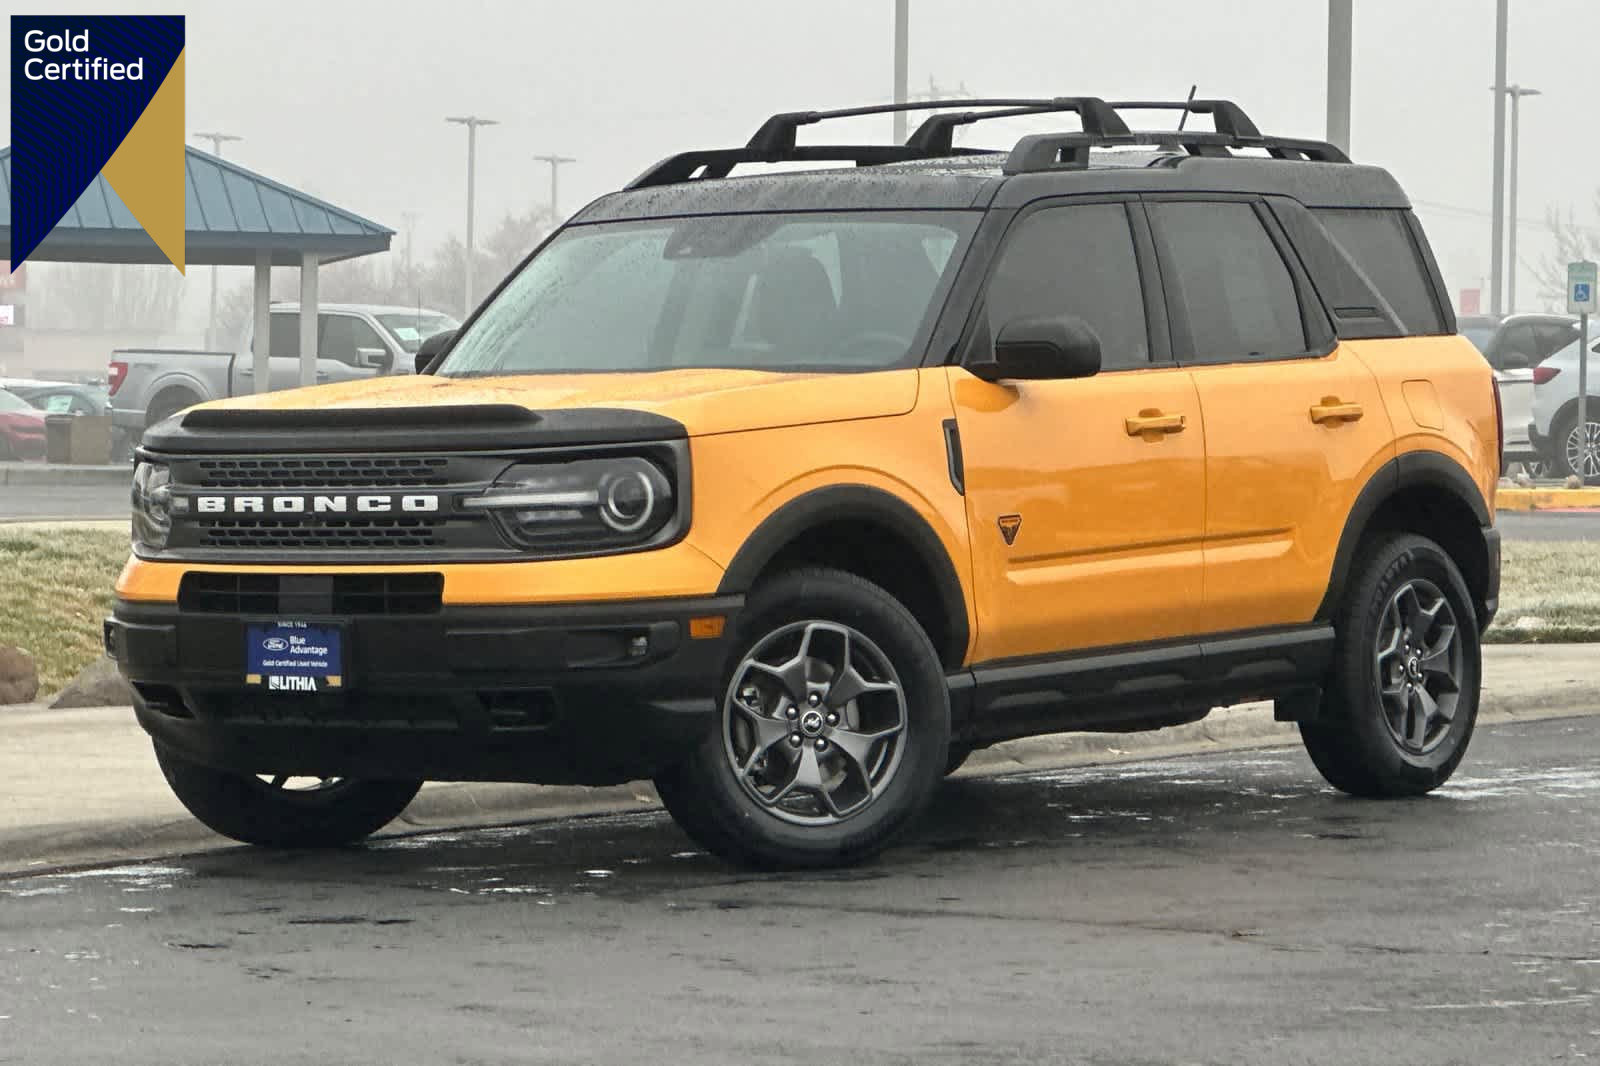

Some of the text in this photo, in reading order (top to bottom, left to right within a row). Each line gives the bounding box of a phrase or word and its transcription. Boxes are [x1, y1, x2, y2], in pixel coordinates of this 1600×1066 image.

[197, 495, 439, 513] BRONCO
[289, 635, 306, 645] Blue
[290, 645, 328, 656] Advantage
[280, 676, 317, 691] LITHIA
